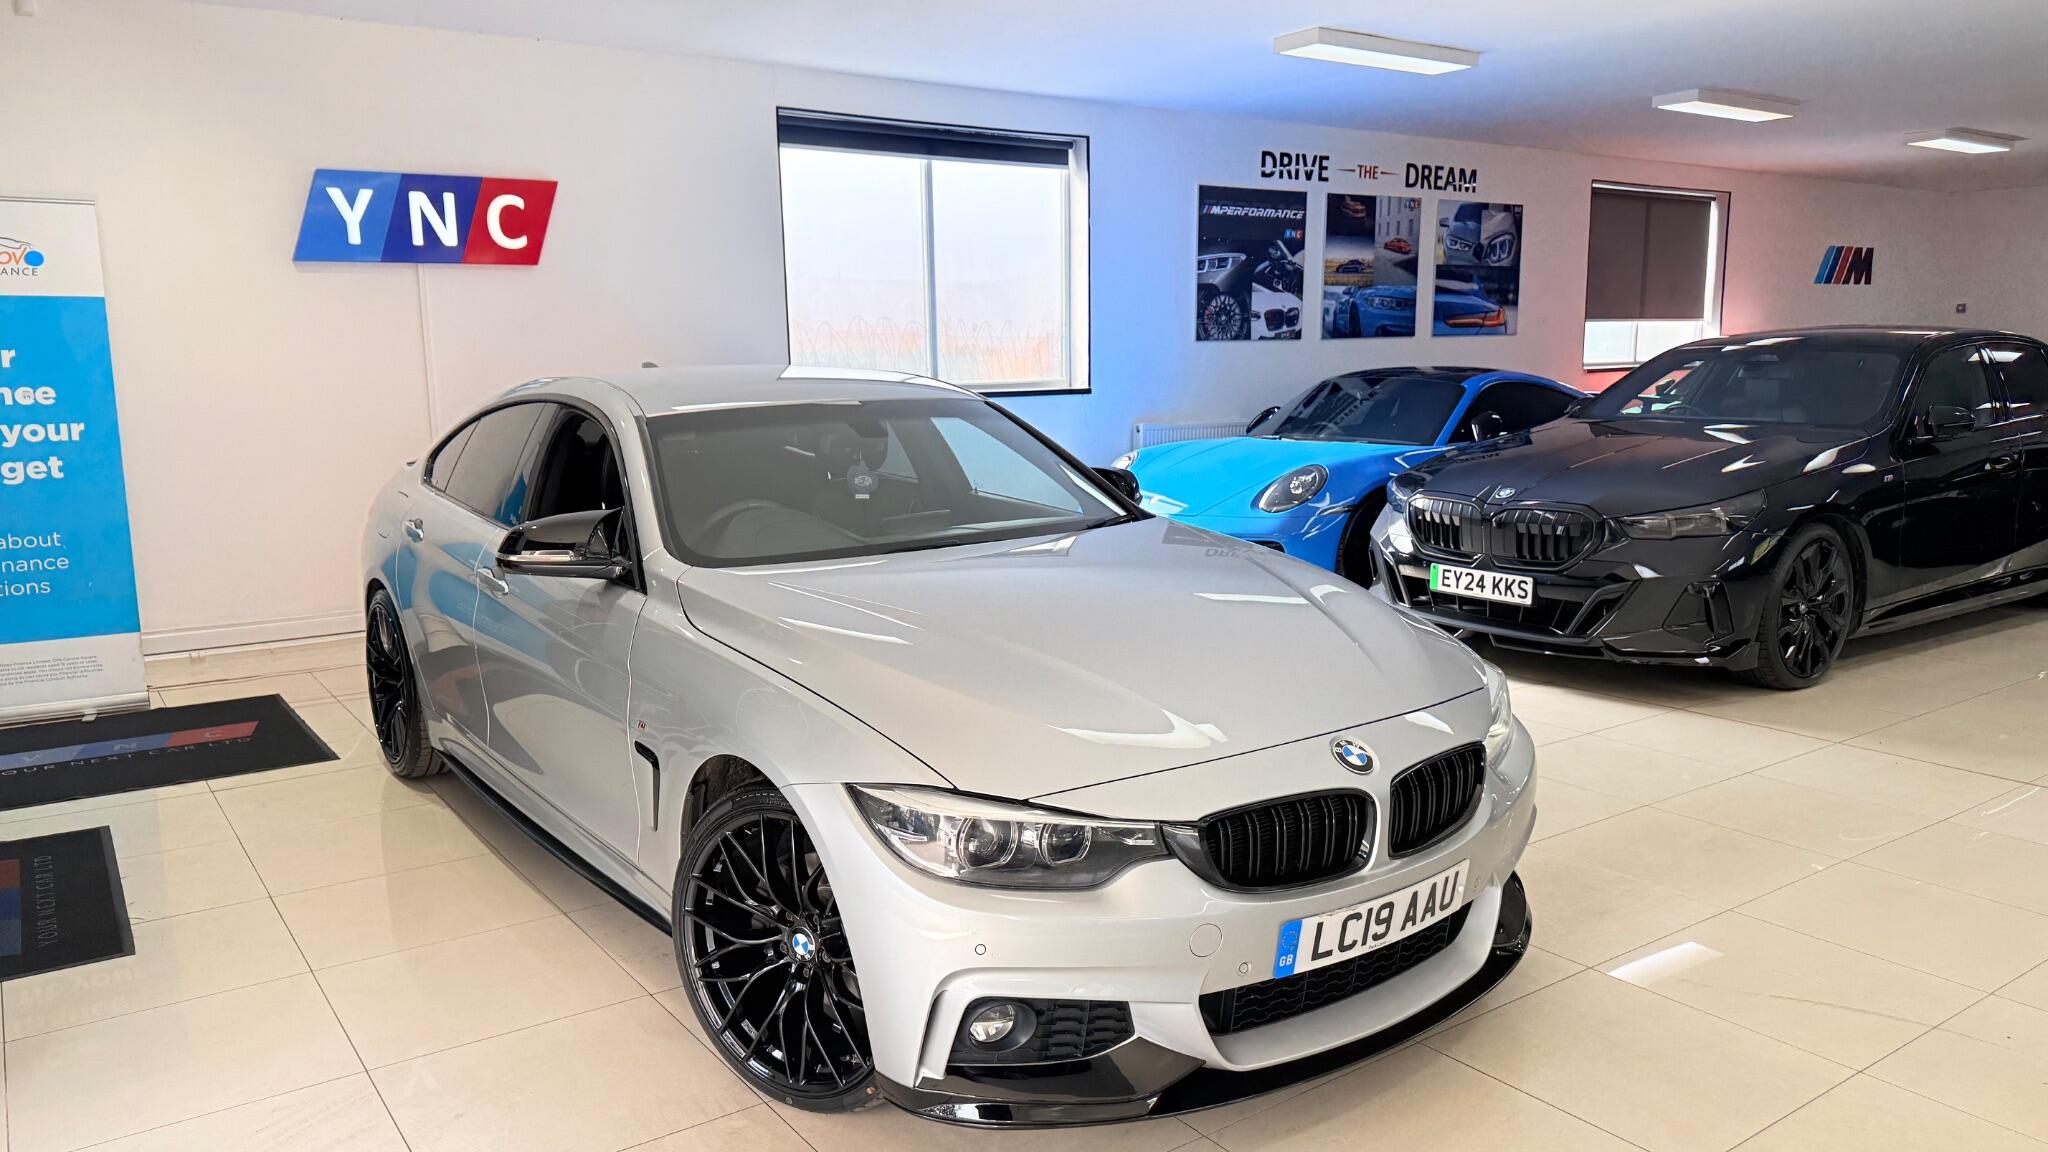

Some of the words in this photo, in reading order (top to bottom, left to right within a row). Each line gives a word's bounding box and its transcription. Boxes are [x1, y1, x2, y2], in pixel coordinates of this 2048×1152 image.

[1261, 151, 1330, 182] DRIVE
[1357, 164, 1379, 180] THE
[1405, 163, 1477, 193] DREAM
[325, 187, 528, 250] YNC
[0, 422, 85, 448] your
[0, 532, 62, 550] about
[1442, 569, 1485, 593] EY24
[1492, 575, 1528, 599] KKS
[33, 855, 53, 871] LTD
[35, 872, 54, 890] CAR
[36, 892, 57, 916] NEXT
[1311, 901, 1395, 962] LC19
[1400, 870, 1460, 932] AAU
[37, 917, 59, 948] YOUR
[1279, 954, 1293, 967] GB
